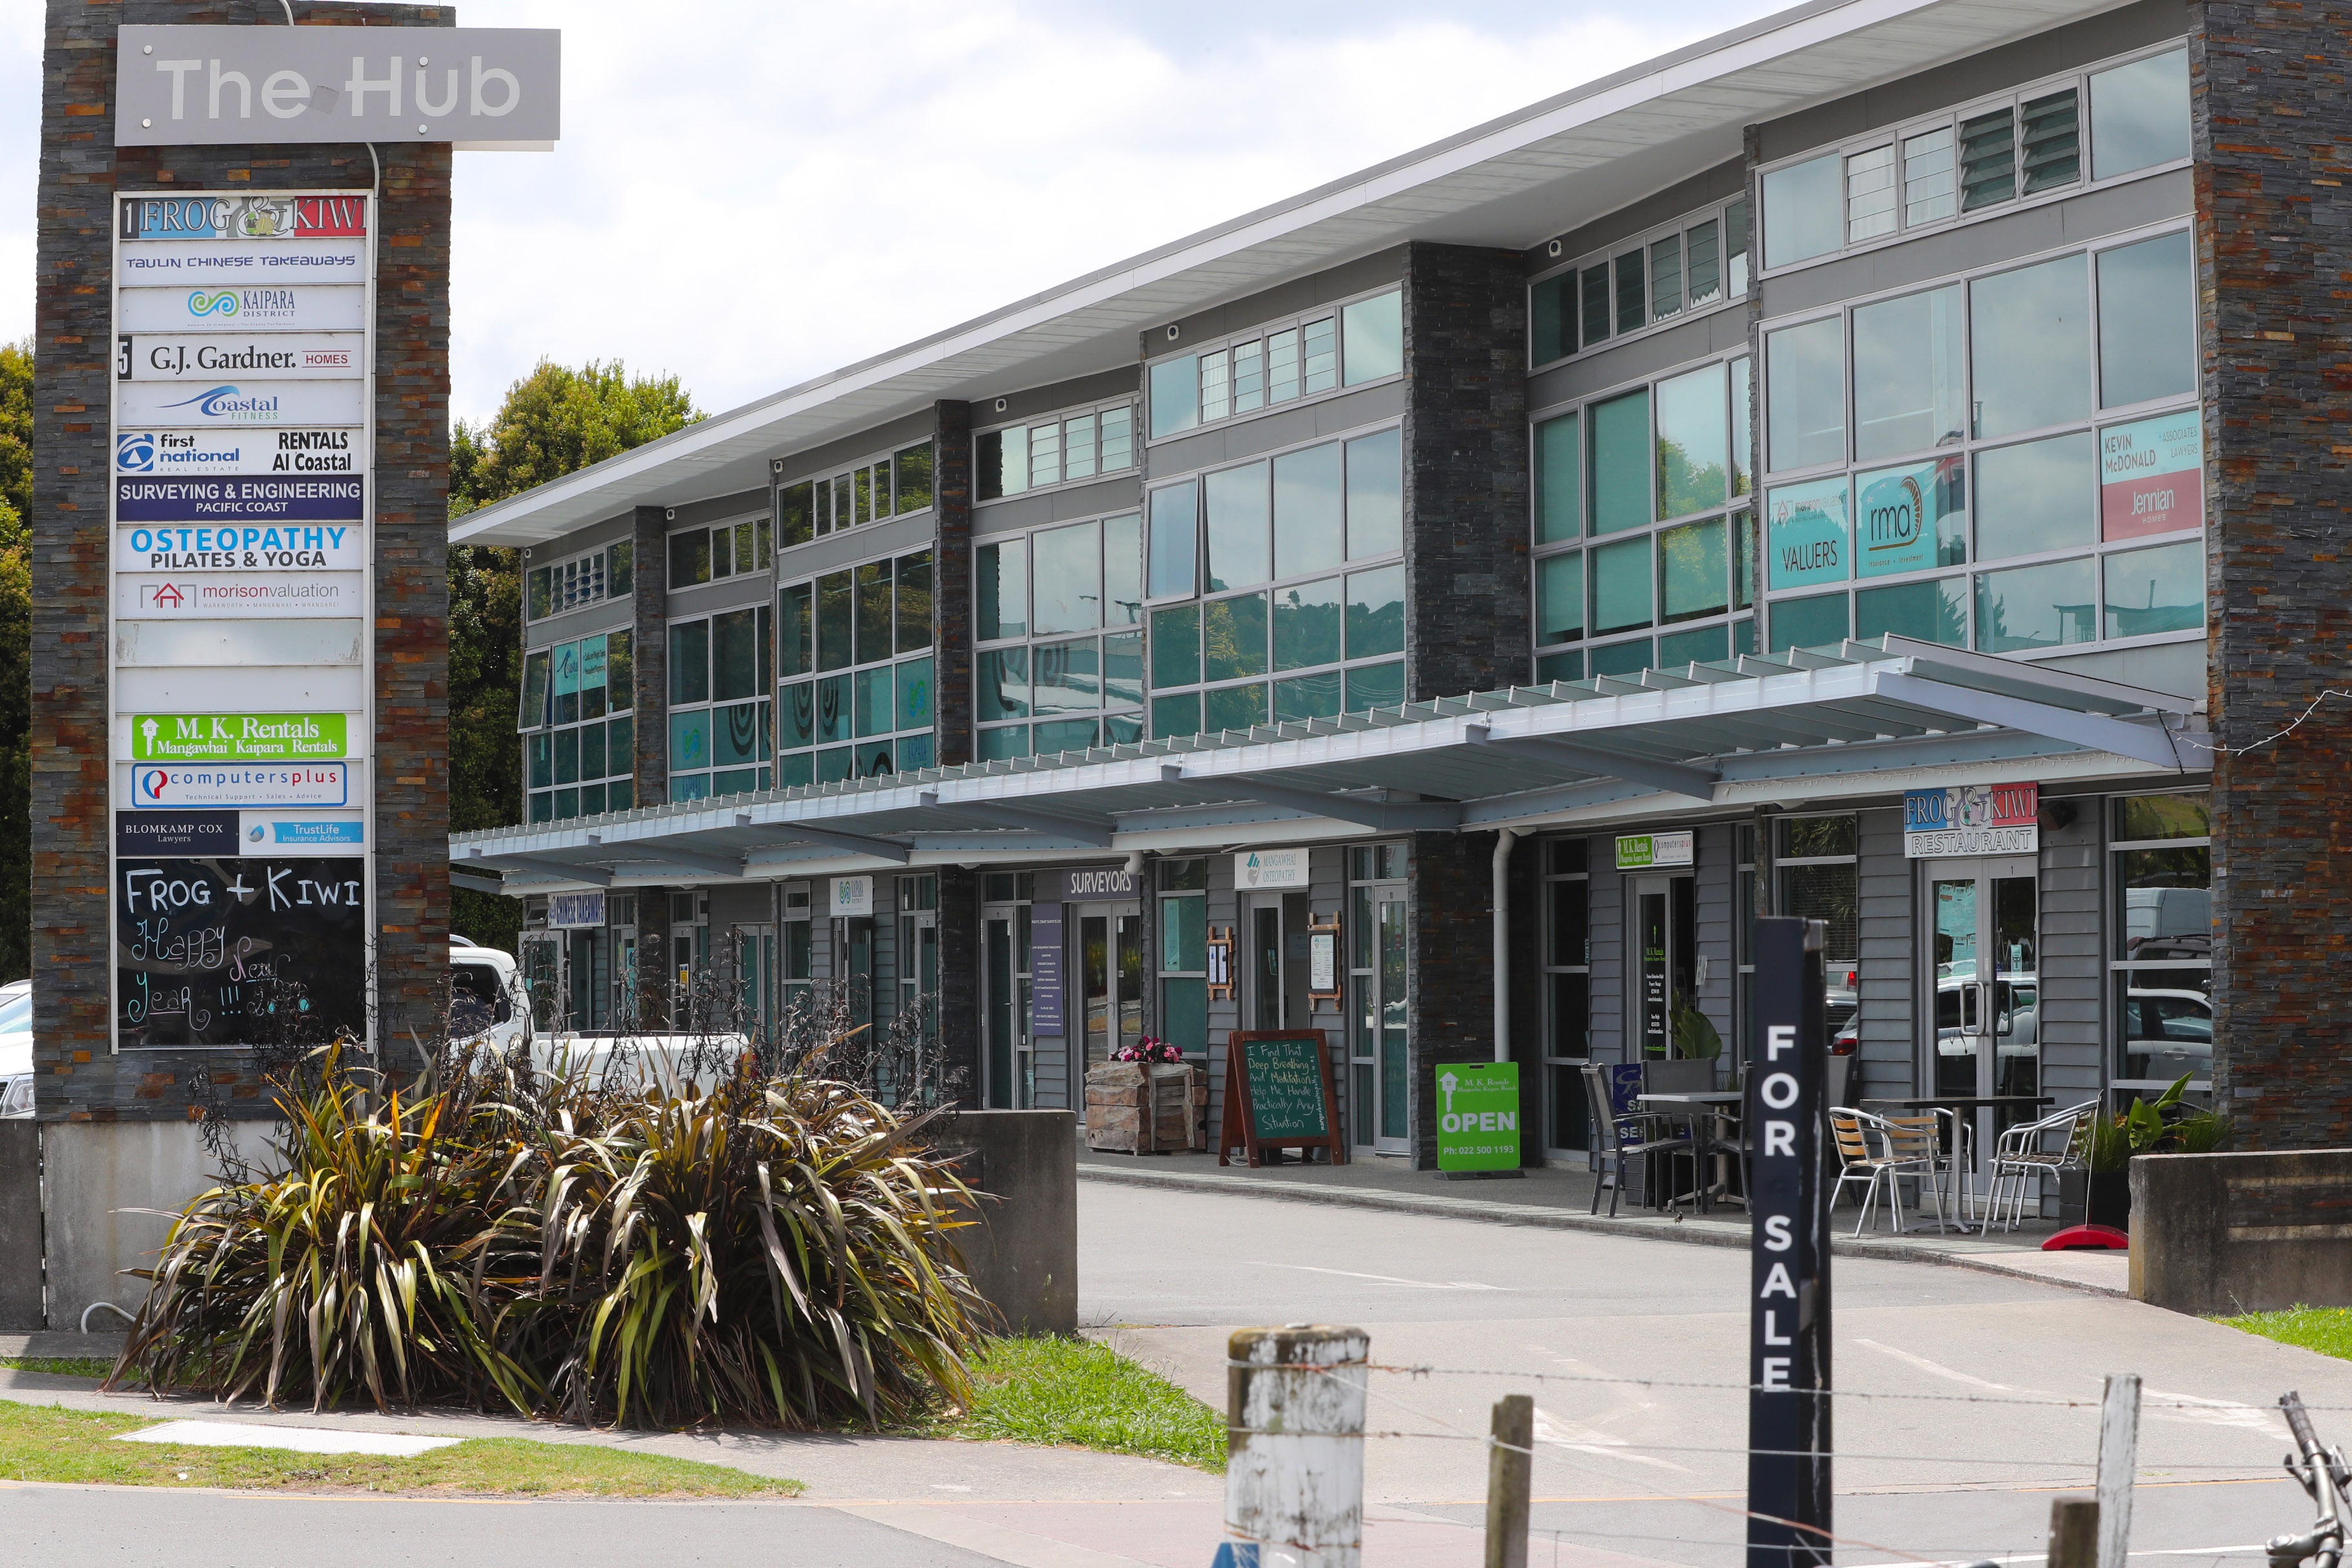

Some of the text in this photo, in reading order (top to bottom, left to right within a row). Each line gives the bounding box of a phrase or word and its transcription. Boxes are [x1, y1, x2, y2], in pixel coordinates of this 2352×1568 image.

[157, 56, 520, 120] The Hub
[126, 202, 132, 233] 1
[141, 199, 232, 231] FROG
[290, 199, 366, 229] KIWI
[188, 257, 253, 267] CHINESE
[244, 291, 295, 309] KAIPARA
[119, 342, 128, 374] 5
[151, 345, 348, 375] G.J. Gardner. HOMES
[201, 393, 279, 416] Coastal
[161, 435, 195, 447] first
[279, 432, 348, 450] RENTALS
[2105, 433, 2132, 454] KEVIN
[160, 449, 239, 462] national
[2171, 444, 2198, 458] LAWYERS
[295, 453, 351, 471] Coastal
[2106, 449, 2156, 474] McDONALD
[121, 483, 360, 500] SURVEYING & ENGINEERING
[196, 502, 288, 513] PACIFIC COAST
[2132, 488, 2174, 515] Jennian
[1871, 504, 1910, 541] rma
[2142, 514, 2166, 524] HOMES
[131, 527, 347, 552] OSTEOPATHY
[151, 551, 326, 568] PILATES & YOGA
[1782, 540, 1837, 572] VALUERS
[203, 583, 338, 598] morisonvaluation
[175, 717, 318, 739] M. K. Rentals
[157, 740, 337, 757] Mangawhai Kaipara Rentals
[171, 770, 337, 787] computersplus
[1905, 794, 1955, 824] FROG
[1989, 789, 2037, 819] KIWI
[126, 825, 195, 833] BLOMKAMP
[294, 824, 339, 834] TrustLife
[158, 834, 191, 843] Lawyers
[1912, 830, 2031, 854] RESTAURANT
[1263, 854, 1296, 867] MANGAWHAI
[1071, 870, 1132, 894] SURVEYORS
[1263, 869, 1295, 882] OSTEOPATHY
[556, 896, 575, 925] CHINESE
[576, 893, 604, 923] TAKEAWAYS
[1247, 1044, 1302, 1057] I Find That
[1248, 1057, 1309, 1075] Deep Breathing
[1250, 1072, 1311, 1084] And Meditation
[1250, 1084, 1311, 1100] Help Me Handle
[1761, 1025, 1799, 1157] FOR
[1253, 1097, 1314, 1115] Practically Any
[1262, 1114, 1304, 1130] Situation
[1442, 1112, 1515, 1133] OPEN
[1760, 1215, 1798, 1393] SALE
